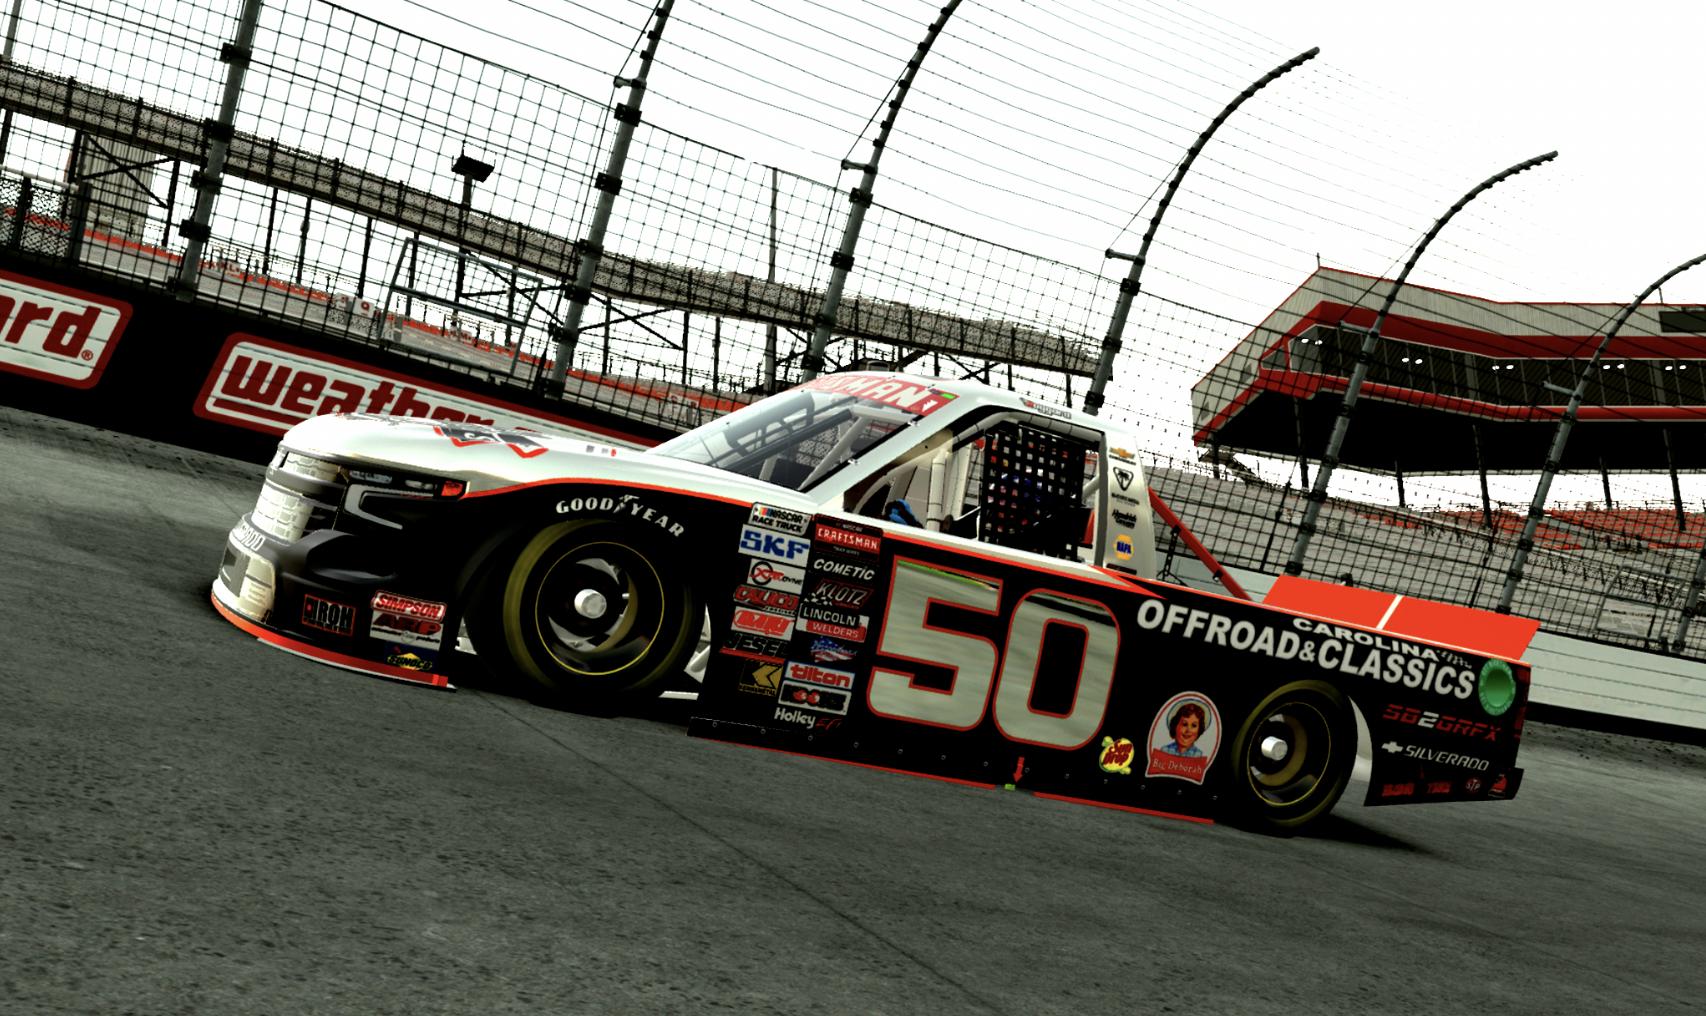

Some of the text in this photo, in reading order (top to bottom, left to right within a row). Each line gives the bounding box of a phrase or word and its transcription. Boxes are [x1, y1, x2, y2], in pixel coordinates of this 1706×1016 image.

[752, 515, 804, 532] RACE TRUCK
[741, 530, 810, 559] SKF
[818, 528, 878, 549] CRAFTSMAN
[814, 559, 875, 580] COMETIC
[816, 583, 868, 606] KLOTZ
[376, 594, 441, 619] SIMPSON
[804, 607, 856, 626] LINCOLN
[813, 622, 859, 638] WELDERS
[1293, 617, 1439, 662] CAROLINA
[387, 655, 432, 670] SUNOCO
[866, 555, 1121, 751] 50
[774, 707, 816, 729] Holley
[1405, 745, 1490, 771] SILVERADO
